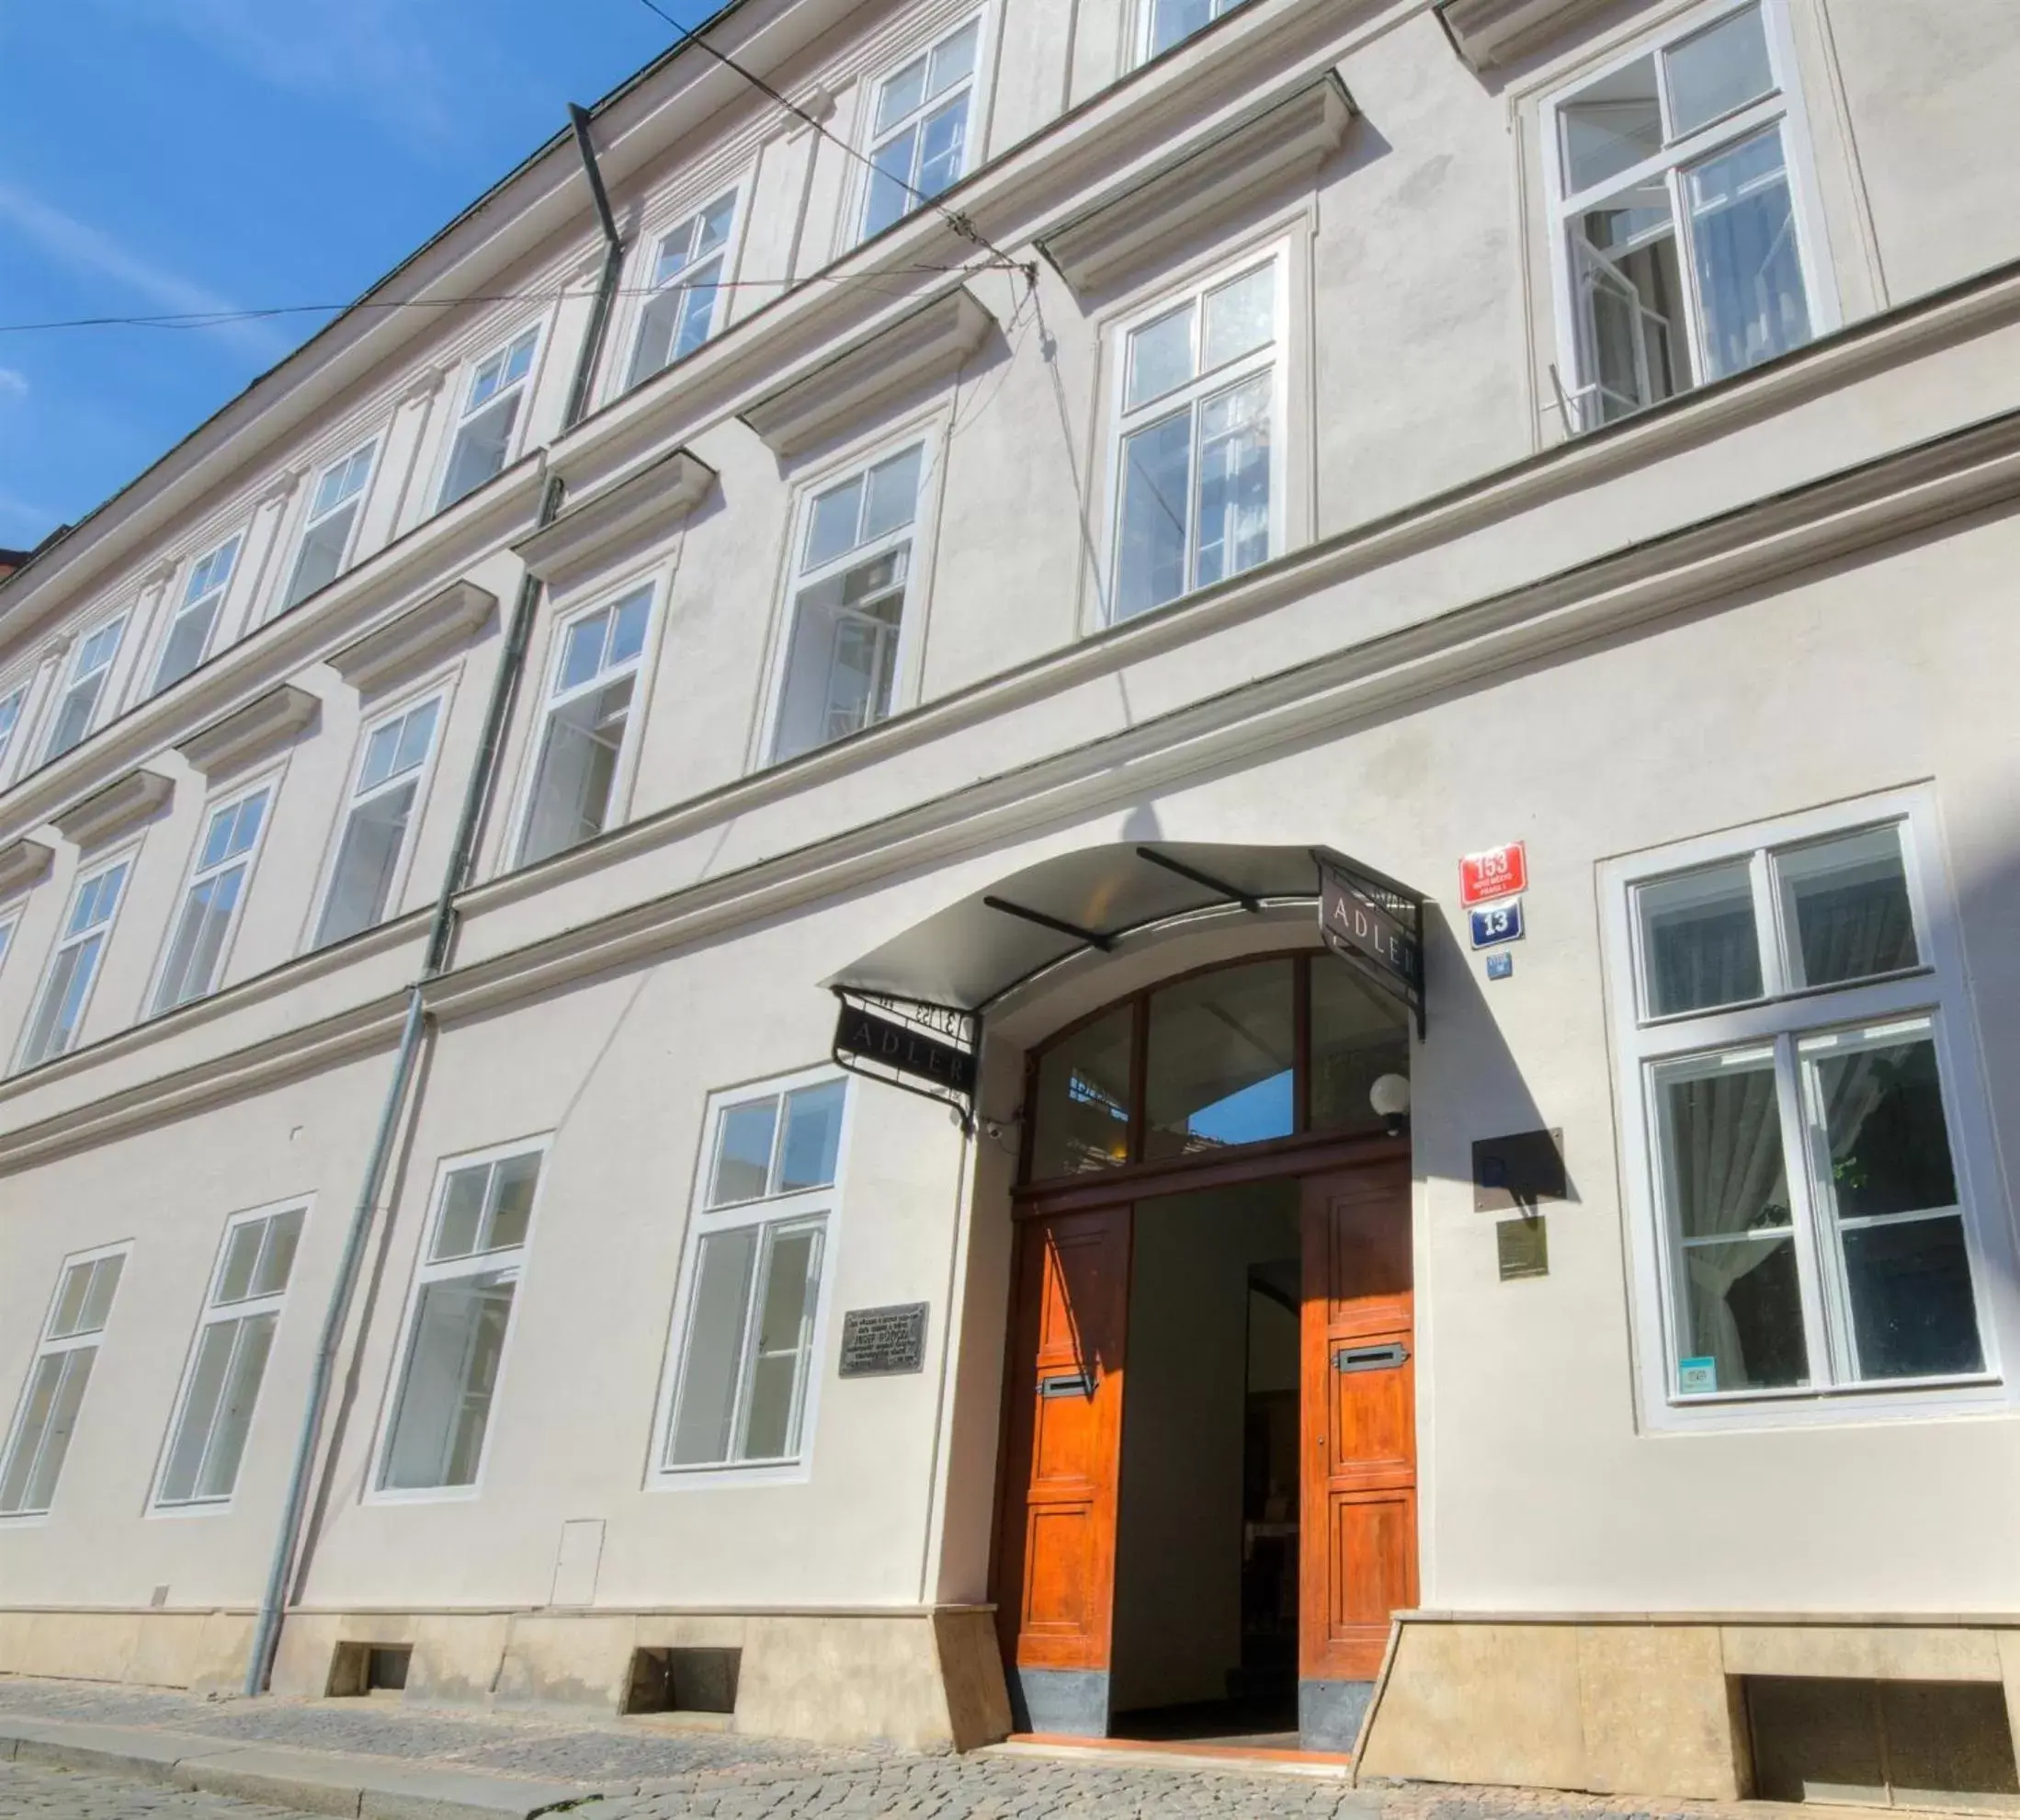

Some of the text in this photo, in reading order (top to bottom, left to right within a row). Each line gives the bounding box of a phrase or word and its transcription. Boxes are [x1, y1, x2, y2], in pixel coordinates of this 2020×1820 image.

[1476, 849, 1509, 881] 153
[1484, 910, 1509, 937] 13
[852, 1020, 963, 1082] ADLER
